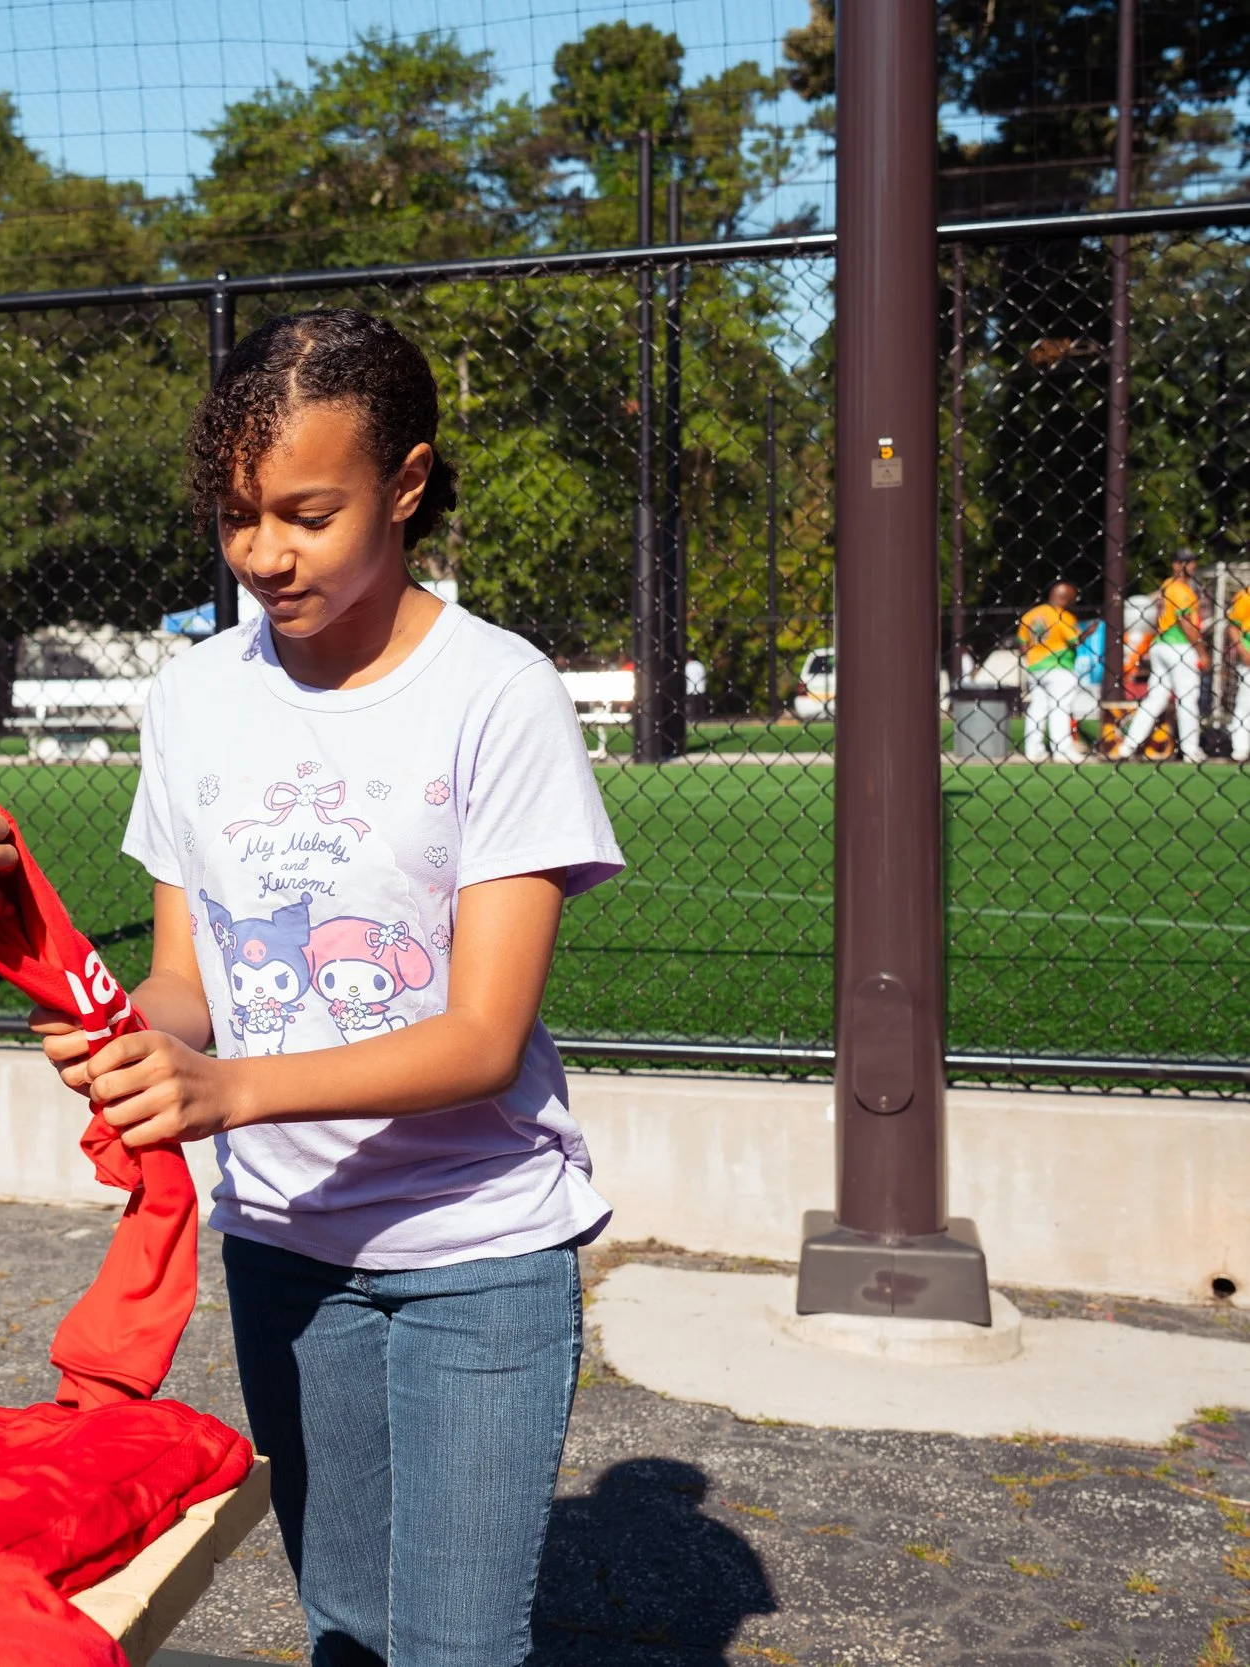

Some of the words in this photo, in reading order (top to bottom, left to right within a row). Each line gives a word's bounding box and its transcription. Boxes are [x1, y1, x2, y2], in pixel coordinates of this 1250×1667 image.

[240, 835, 275, 862] My
[281, 832, 350, 864] Melody
[280, 857, 310, 871] and
[258, 872, 335, 899] Kuromi
